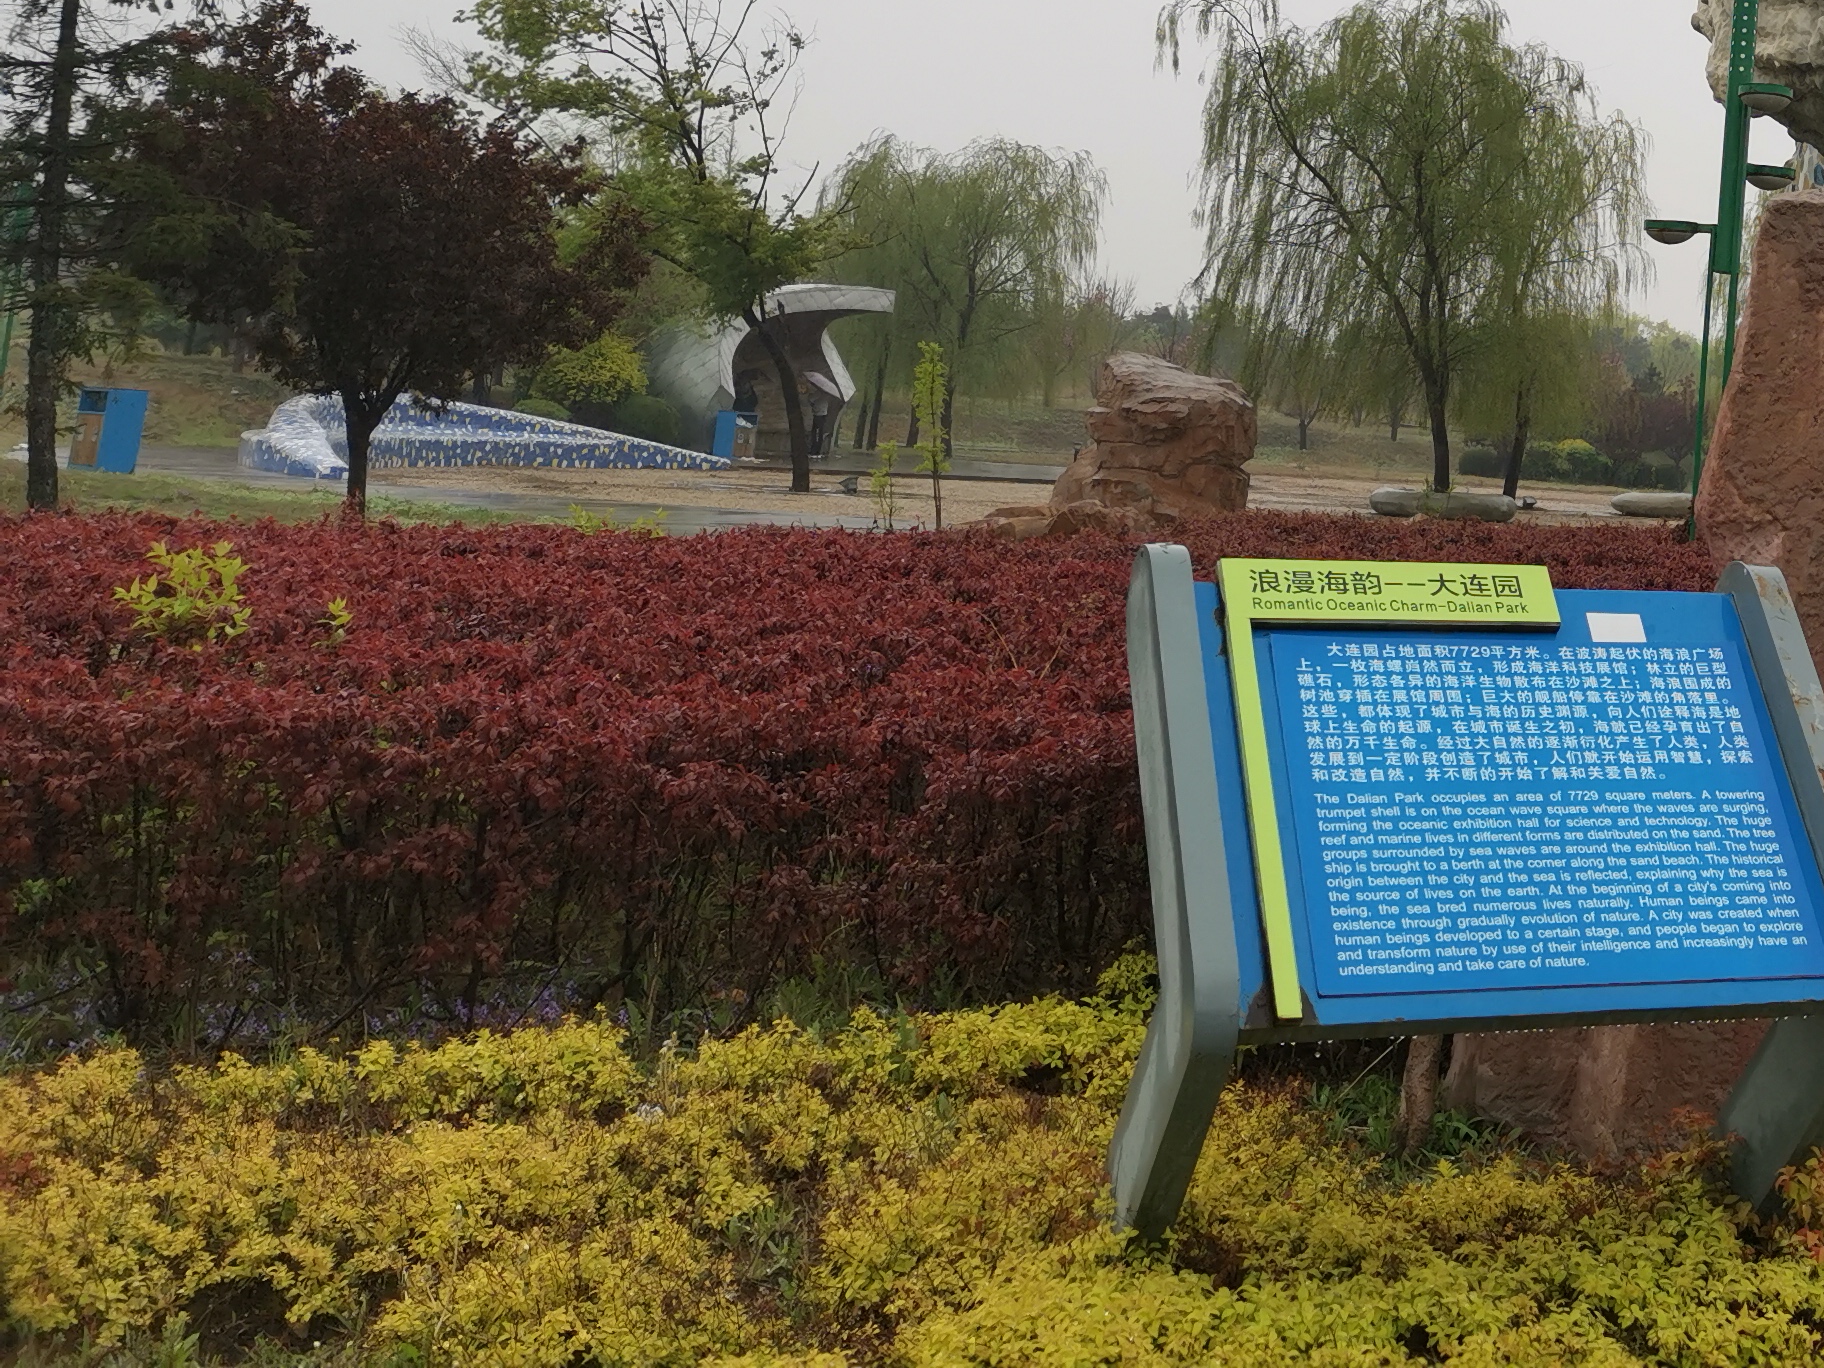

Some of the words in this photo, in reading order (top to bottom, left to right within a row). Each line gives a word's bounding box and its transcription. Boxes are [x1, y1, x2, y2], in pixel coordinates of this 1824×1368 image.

[1252, 597, 1323, 610] Romantic
[1326, 598, 1387, 611] Oceanic
[1390, 599, 1493, 612] Charm-Dalian
[1495, 601, 1529, 614] Park
[1314, 793, 1339, 803] The
[1347, 792, 1387, 803] Dalian
[1395, 791, 1424, 803] Park
[1431, 791, 1486, 804] occupies
[1516, 792, 1543, 801] area
[1568, 790, 1598, 800] 7729
[1605, 791, 1645, 802] square
[1652, 789, 1695, 799] meters.
[1716, 789, 1765, 801] towering
[1316, 806, 1366, 819] trumpet
[1371, 805, 1400, 816] shell
[1442, 805, 1462, 815] the
[1467, 806, 1505, 815] ocean
[1509, 806, 1542, 815] wave
[1547, 805, 1588, 816] square
[1592, 803, 1629, 813] where
[1634, 803, 1653, 813] the
[1657, 803, 1695, 812] waves
[1700, 803, 1718, 812] are
[1723, 801, 1768, 814] surging,
[1319, 820, 1367, 832] forming
[1372, 819, 1392, 830] the
[1399, 819, 1448, 830] oceanic
[1453, 817, 1512, 829] exhibition
[1517, 817, 1539, 827] hall
[1544, 816, 1560, 827] for
[1566, 816, 1612, 827] science
[1618, 815, 1639, 826] and
[1644, 815, 1710, 827] technology.
[1714, 815, 1738, 825] The
[1742, 815, 1771, 827] huge
[1321, 833, 1346, 845] reef
[1350, 833, 1374, 844] and
[1378, 833, 1421, 844] marine
[1425, 832, 1454, 843] lives
[1473, 831, 1523, 842] different
[1526, 830, 1561, 840] forms
[1564, 831, 1583, 840] are
[1588, 828, 1649, 839] distributed
[1670, 828, 1689, 838] the
[1693, 827, 1724, 838] sand.
[1726, 827, 1750, 837] The
[1753, 827, 1775, 837] tree
[1323, 849, 1367, 861] groups
[1372, 846, 1444, 858] surrounded
[1449, 845, 1464, 858] by
[1469, 847, 1492, 855] sea
[1496, 845, 1536, 855] waves
[1541, 845, 1561, 854] are
[1566, 842, 1608, 853] around
[1612, 842, 1631, 852] the
[1636, 841, 1691, 852] exhibition
[1695, 840, 1720, 851] hall.
[1723, 840, 1747, 851] The
[1750, 840, 1779, 853] huge
[1325, 861, 1352, 875] ship
[1370, 860, 1420, 873] brought
[1452, 858, 1484, 870] berth
[1487, 858, 1501, 869] at
[1504, 857, 1523, 868] the
[1528, 858, 1566, 867] corner
[1571, 856, 1604, 868] along
[1607, 855, 1627, 865] the
[1630, 854, 1659, 865] sand
[1662, 854, 1703, 865] beach.
[1705, 853, 1729, 864] The
[1732, 853, 1783, 864] historical
[1327, 875, 1363, 889] origin
[1368, 875, 1423, 886] between
[1428, 873, 1448, 885] the
[1454, 873, 1474, 886] city
[1480, 871, 1503, 883] and
[1508, 871, 1528, 882] the
[1533, 872, 1556, 881] sea
[1576, 869, 1631, 880] reflected,
[1636, 867, 1697, 881] explaining
[1700, 867, 1724, 880] why
[1729, 867, 1747, 877] the
[1752, 869, 1773, 877] sea
[1329, 890, 1349, 901] the
[1356, 890, 1400, 900] source
[1405, 887, 1418, 899] of
[1424, 887, 1453, 898] lives
[1481, 886, 1501, 897] the
[1508, 885, 1543, 896] earth.
[1549, 884, 1563, 895] At
[1567, 884, 1587, 894] the
[1592, 883, 1652, 896] beginning
[1688, 880, 1717, 893] city's
[1722, 880, 1765, 893] coming
[1769, 880, 1791, 890] into
[1331, 904, 1371, 917] being,
[1378, 903, 1399, 914] the
[1407, 904, 1430, 914] sea
[1437, 901, 1466, 912] bred
[1473, 901, 1536, 911] numerous
[1543, 898, 1571, 909] lives
[1578, 896, 1633, 909] naturally.
[1639, 896, 1683, 907] Human
[1689, 894, 1729, 907] beings
[1735, 895, 1767, 904] came
[1773, 893, 1795, 903] into
[1333, 919, 1395, 930] existence
[1401, 915, 1451, 930] through
[1457, 913, 1515, 929] gradually
[1521, 913, 1577, 924] evolution
[1601, 911, 1643, 921] nature.
[1663, 909, 1682, 922] city
[1688, 910, 1713, 919] was
[1718, 906, 1762, 918] created
[1767, 907, 1799, 917] when
[1335, 934, 1380, 945] human
[1386, 932, 1430, 945] beings
[1435, 928, 1502, 942] developed
[1538, 926, 1580, 938] certain
[1585, 925, 1623, 938] stage,
[1628, 924, 1651, 935] and
[1656, 922, 1697, 937] people
[1701, 922, 1739, 935] began
[1760, 920, 1803, 933] explore
[1337, 948, 1362, 960] and
[1367, 946, 1430, 959] transform
[1436, 945, 1477, 957] nature
[1482, 943, 1497, 957] by
[1503, 944, 1526, 954] use
[1548, 940, 1576, 952] their
[1581, 939, 1651, 952] intelligence
[1656, 937, 1678, 948] and
[1683, 935, 1753, 948] increasingly
[1758, 935, 1787, 945] have
[1339, 961, 1434, 975] understanding
[1438, 959, 1462, 971] and
[1466, 958, 1494, 970] take
[1498, 959, 1526, 969] care
[1545, 955, 1589, 967] nature.
